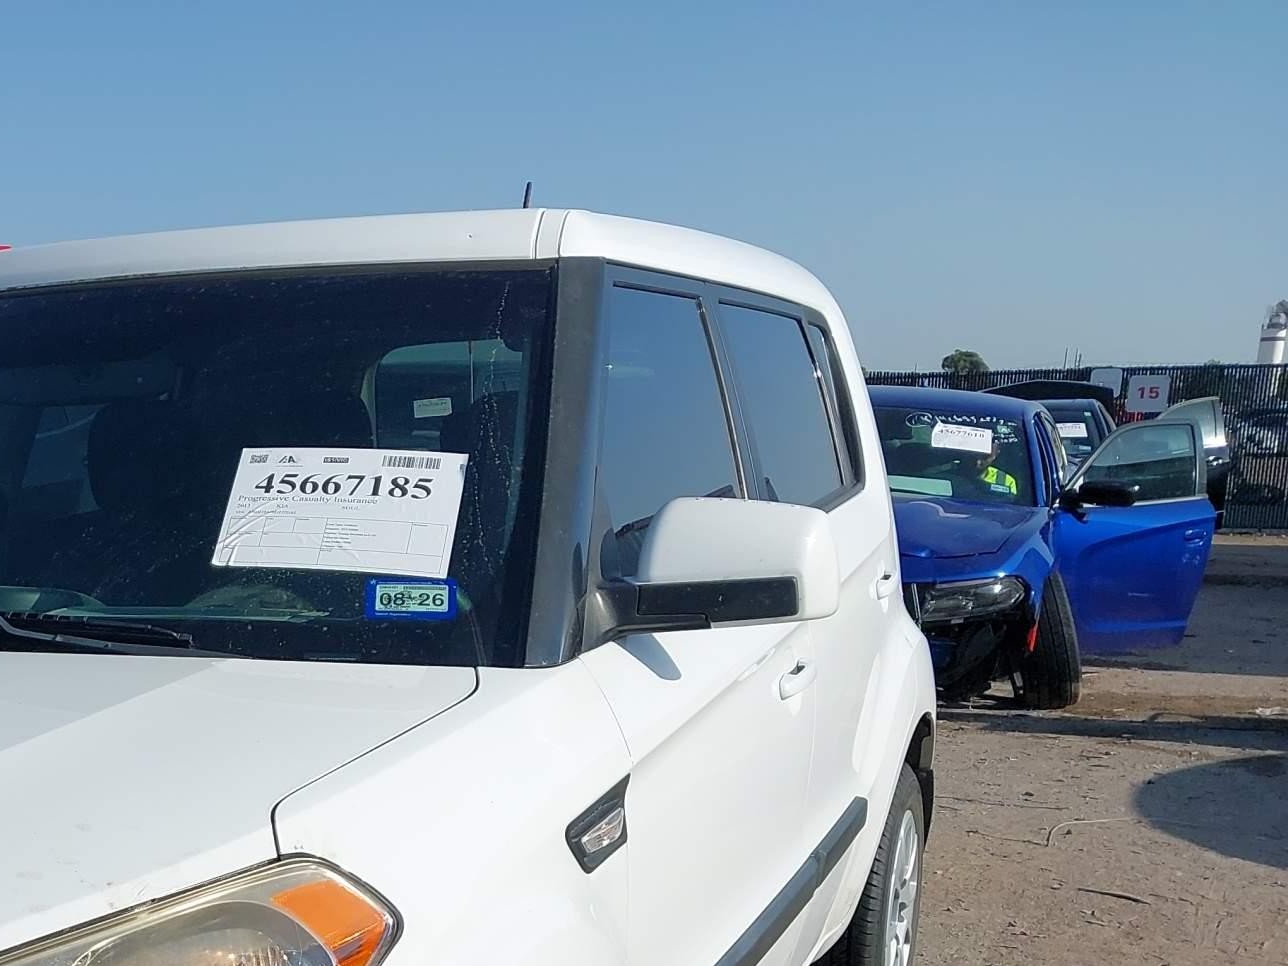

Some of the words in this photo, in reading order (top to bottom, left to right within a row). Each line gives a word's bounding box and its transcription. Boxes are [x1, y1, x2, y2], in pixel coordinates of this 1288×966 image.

[1137, 386, 1161, 399] 15
[254, 473, 433, 499] 45667185
[238, 494, 290, 503] Progressive
[292, 495, 332, 504] Casualty
[334, 496, 378, 505] Insurance
[417, 592, 444, 607] 26
